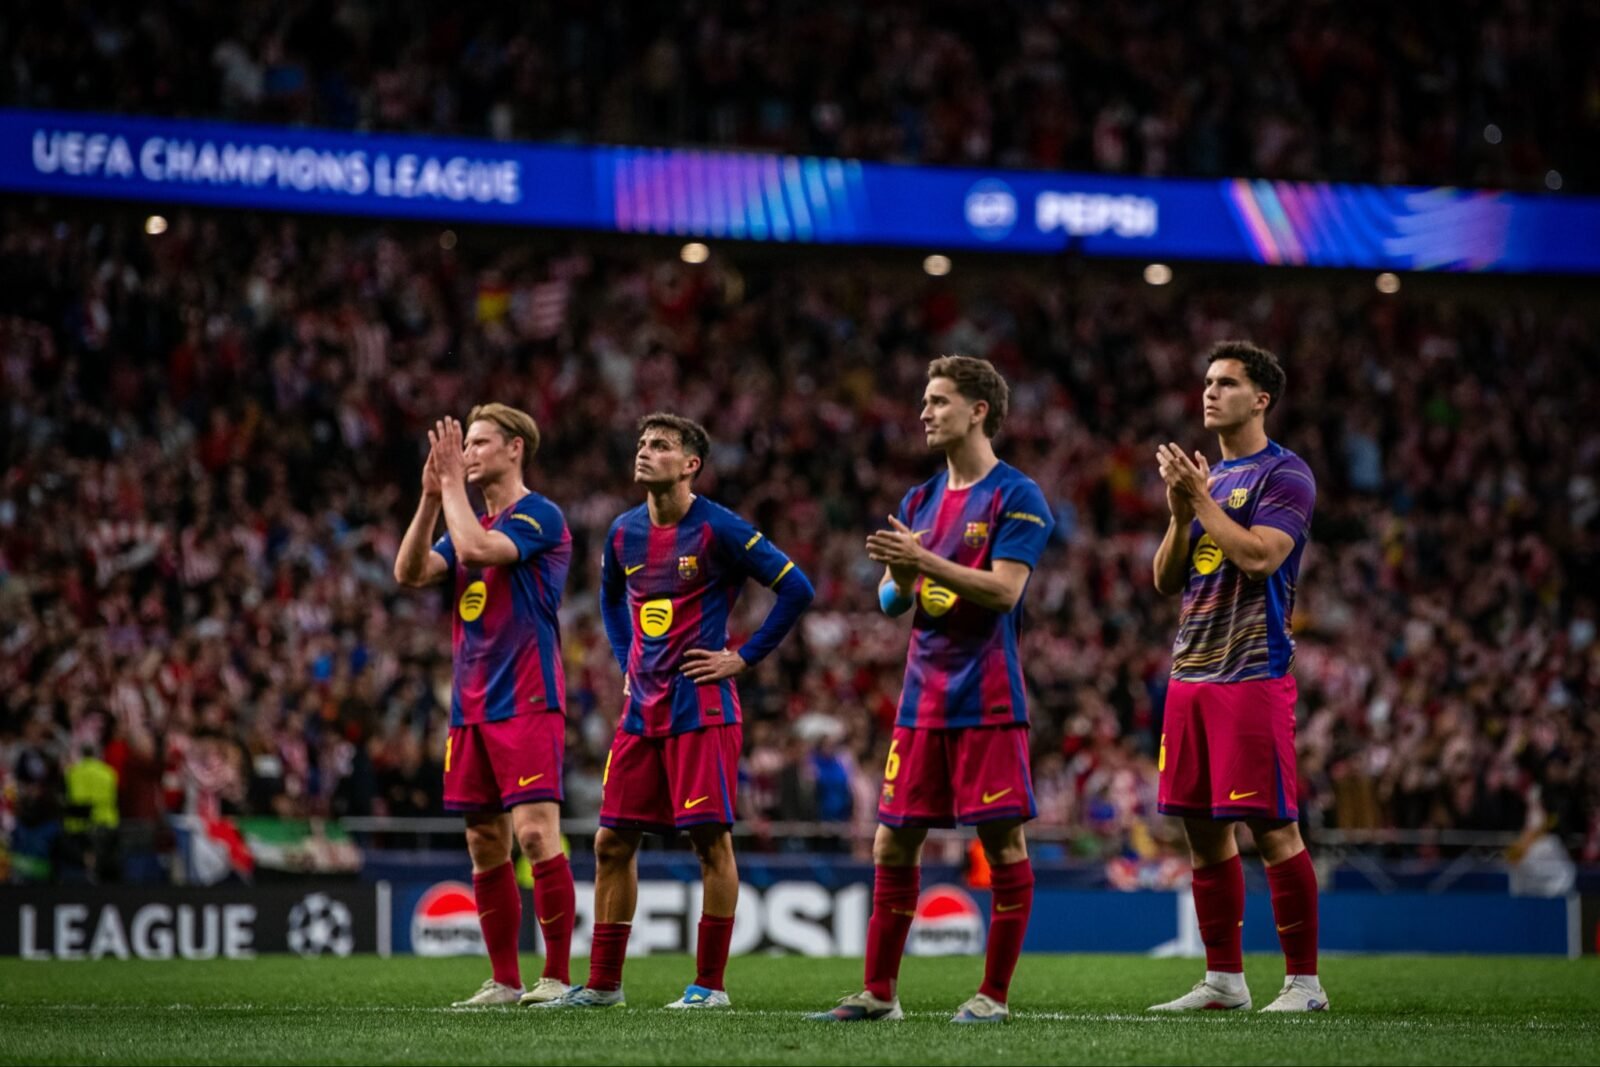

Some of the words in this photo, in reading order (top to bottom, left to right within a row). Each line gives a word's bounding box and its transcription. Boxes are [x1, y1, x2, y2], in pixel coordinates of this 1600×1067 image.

[32, 128, 135, 179] UEFA
[139, 136, 370, 195] CHAMPIONS
[373, 151, 521, 204] LEAGUE
[1035, 190, 1159, 238] PEPSI
[885, 739, 901, 781] 6
[18, 902, 257, 960] LEAGUE
